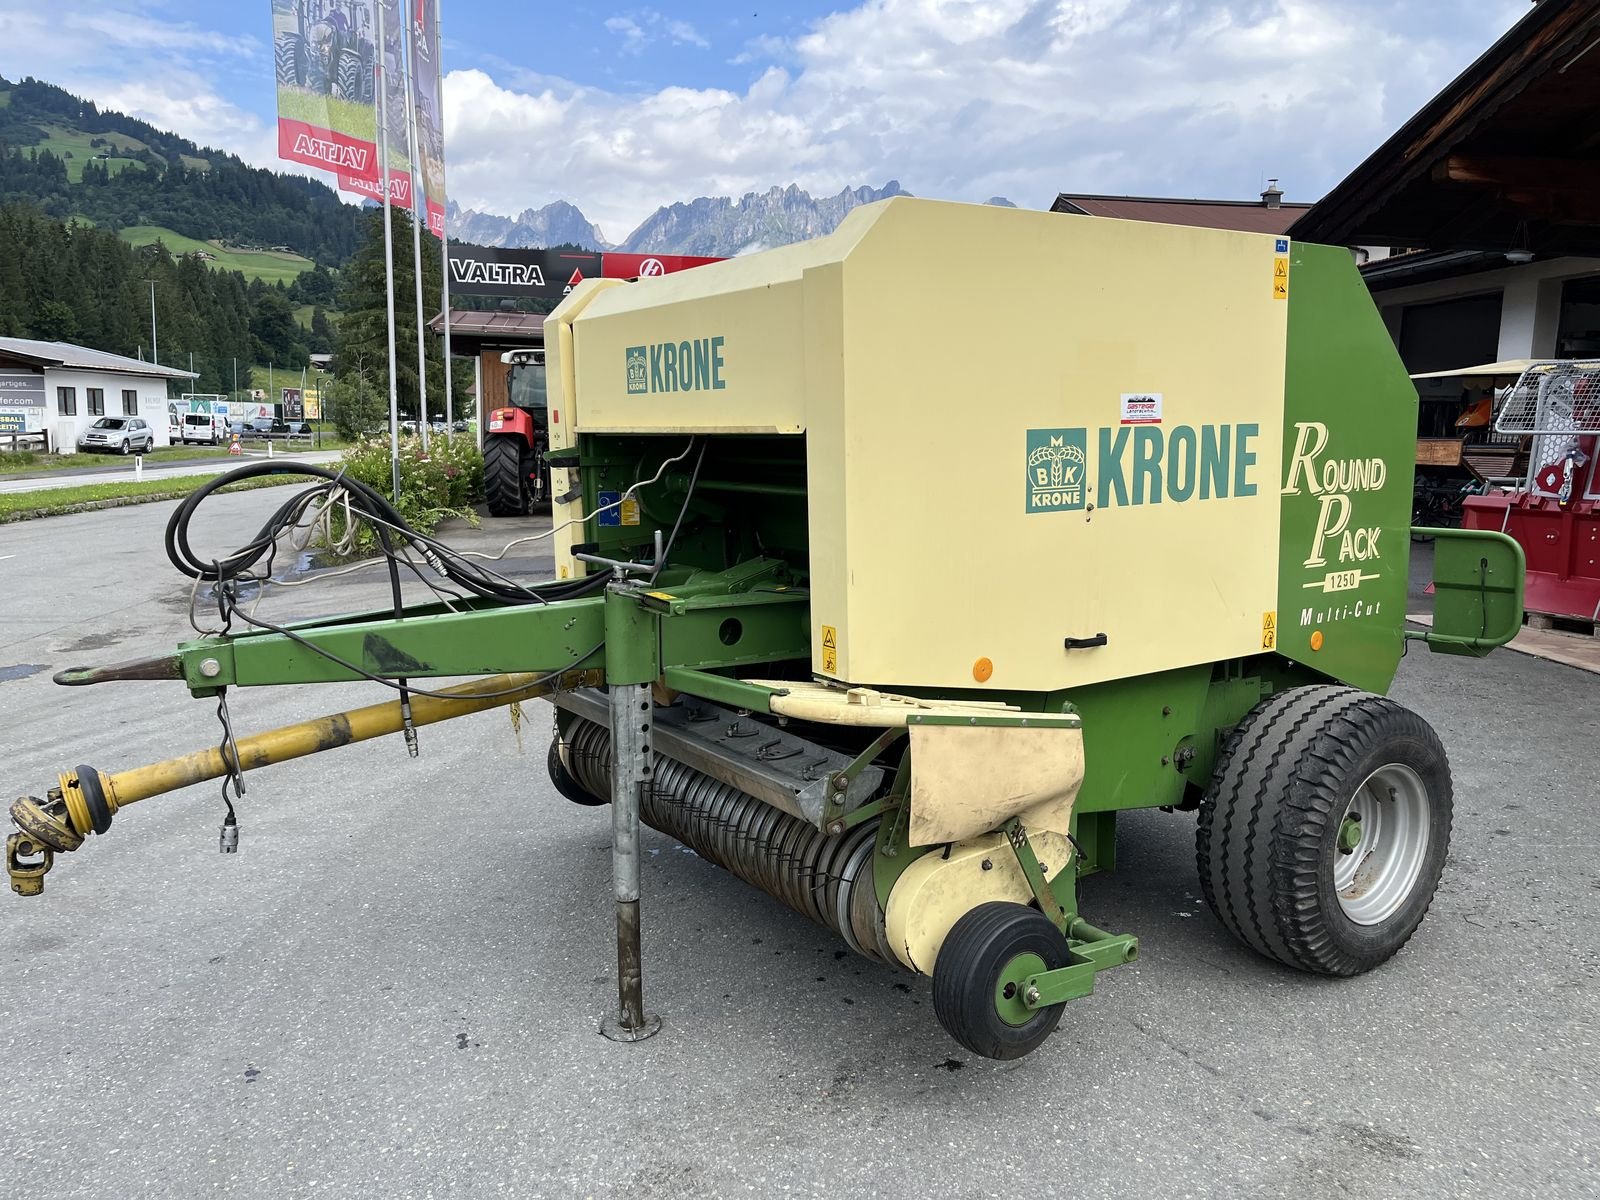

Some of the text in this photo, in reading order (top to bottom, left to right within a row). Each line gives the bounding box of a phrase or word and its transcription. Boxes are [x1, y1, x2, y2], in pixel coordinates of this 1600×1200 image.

[449, 258, 545, 286] VALTRA
[650, 336, 726, 393] KRONE
[1051, 435, 1063, 447] M
[1036, 466, 1078, 485] B K
[1097, 423, 1259, 508] KRONE
[1031, 491, 1080, 507] KRONE
[1330, 572, 1355, 589] 1250
[1300, 600, 1381, 627] Multi-Cut
